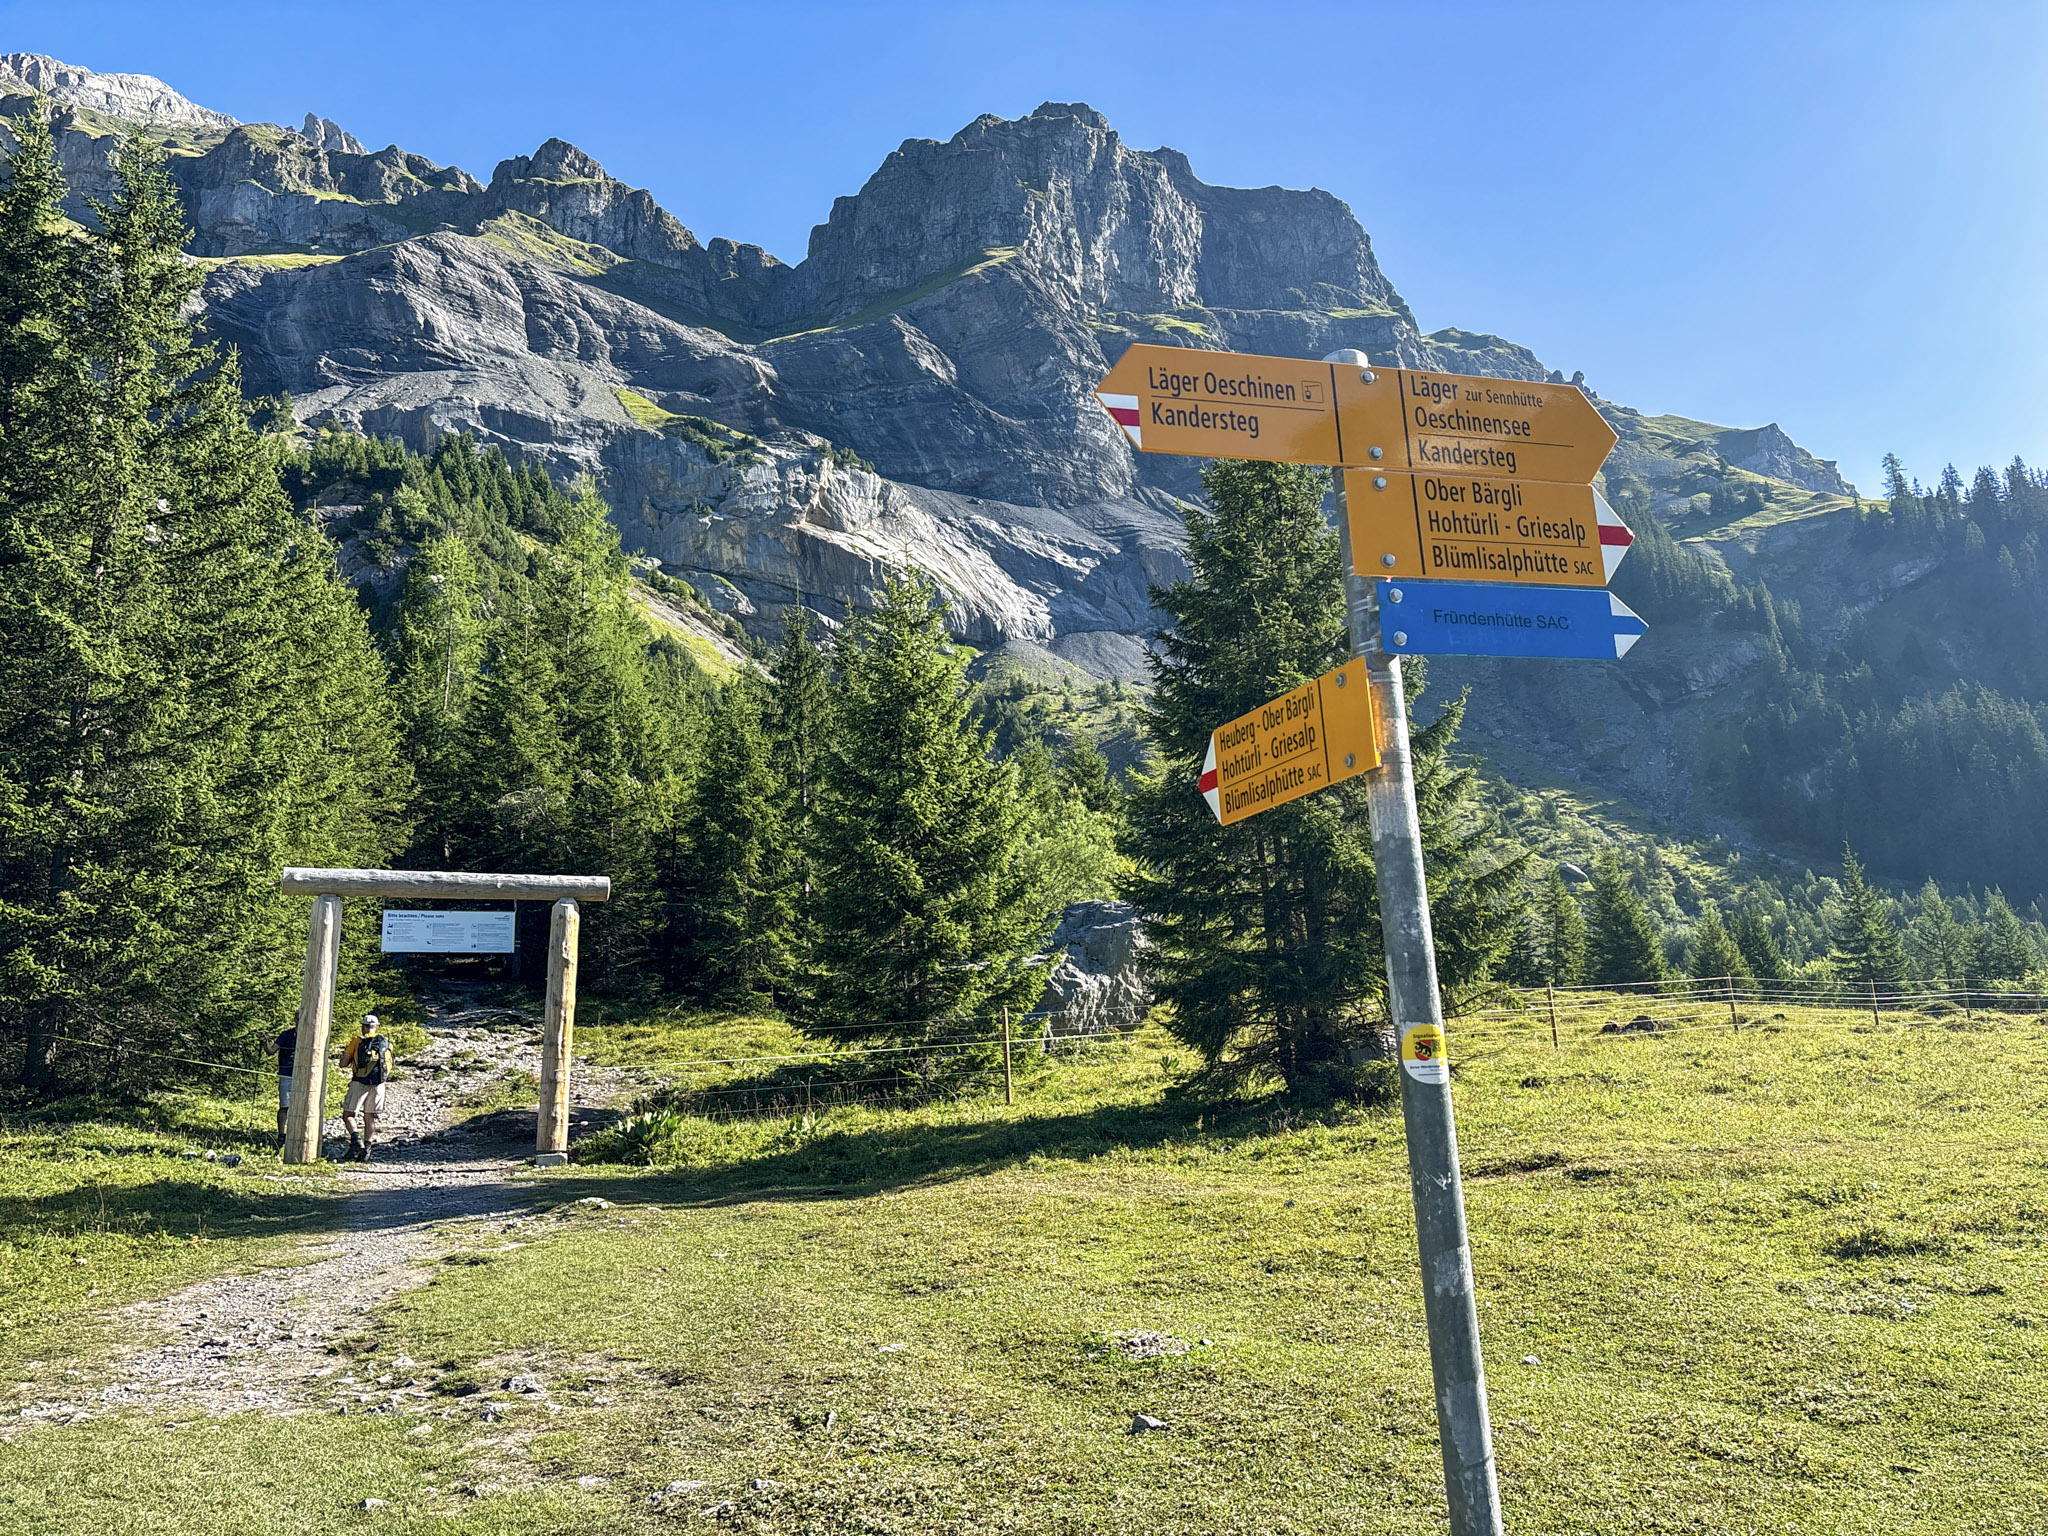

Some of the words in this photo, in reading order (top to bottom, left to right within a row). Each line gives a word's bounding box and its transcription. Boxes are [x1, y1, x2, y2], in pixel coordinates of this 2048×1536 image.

[1148, 366, 1199, 397] Läger
[1204, 371, 1296, 401] Oeschinen
[1411, 375, 1458, 404] Läger
[1464, 389, 1483, 403] zur
[1485, 388, 1543, 408] Sennhütte
[1151, 402, 1260, 439] Kandersteg
[1414, 406, 1531, 437] Oeschinensee
[1418, 439, 1517, 474] Kandersteg
[1424, 478, 1466, 503] Ober
[1472, 482, 1523, 512] Bärgli
[1428, 510, 1500, 536] Hohtürli
[1516, 515, 1586, 546] Griesalp
[1432, 545, 1568, 578] Blümlisalphütte
[1573, 561, 1594, 575] SAC
[1433, 609, 1533, 629] Fründenhütte
[1536, 614, 1569, 631] SAC
[1219, 721, 1256, 753] Heuberg
[1262, 706, 1286, 732] Ober
[1285, 686, 1315, 720] Bärgli
[1221, 743, 1262, 782] Hohtürli
[1270, 721, 1316, 759] Griesalp
[1224, 766, 1305, 815] Blümlisalphütte
[1307, 763, 1322, 782] SAC
